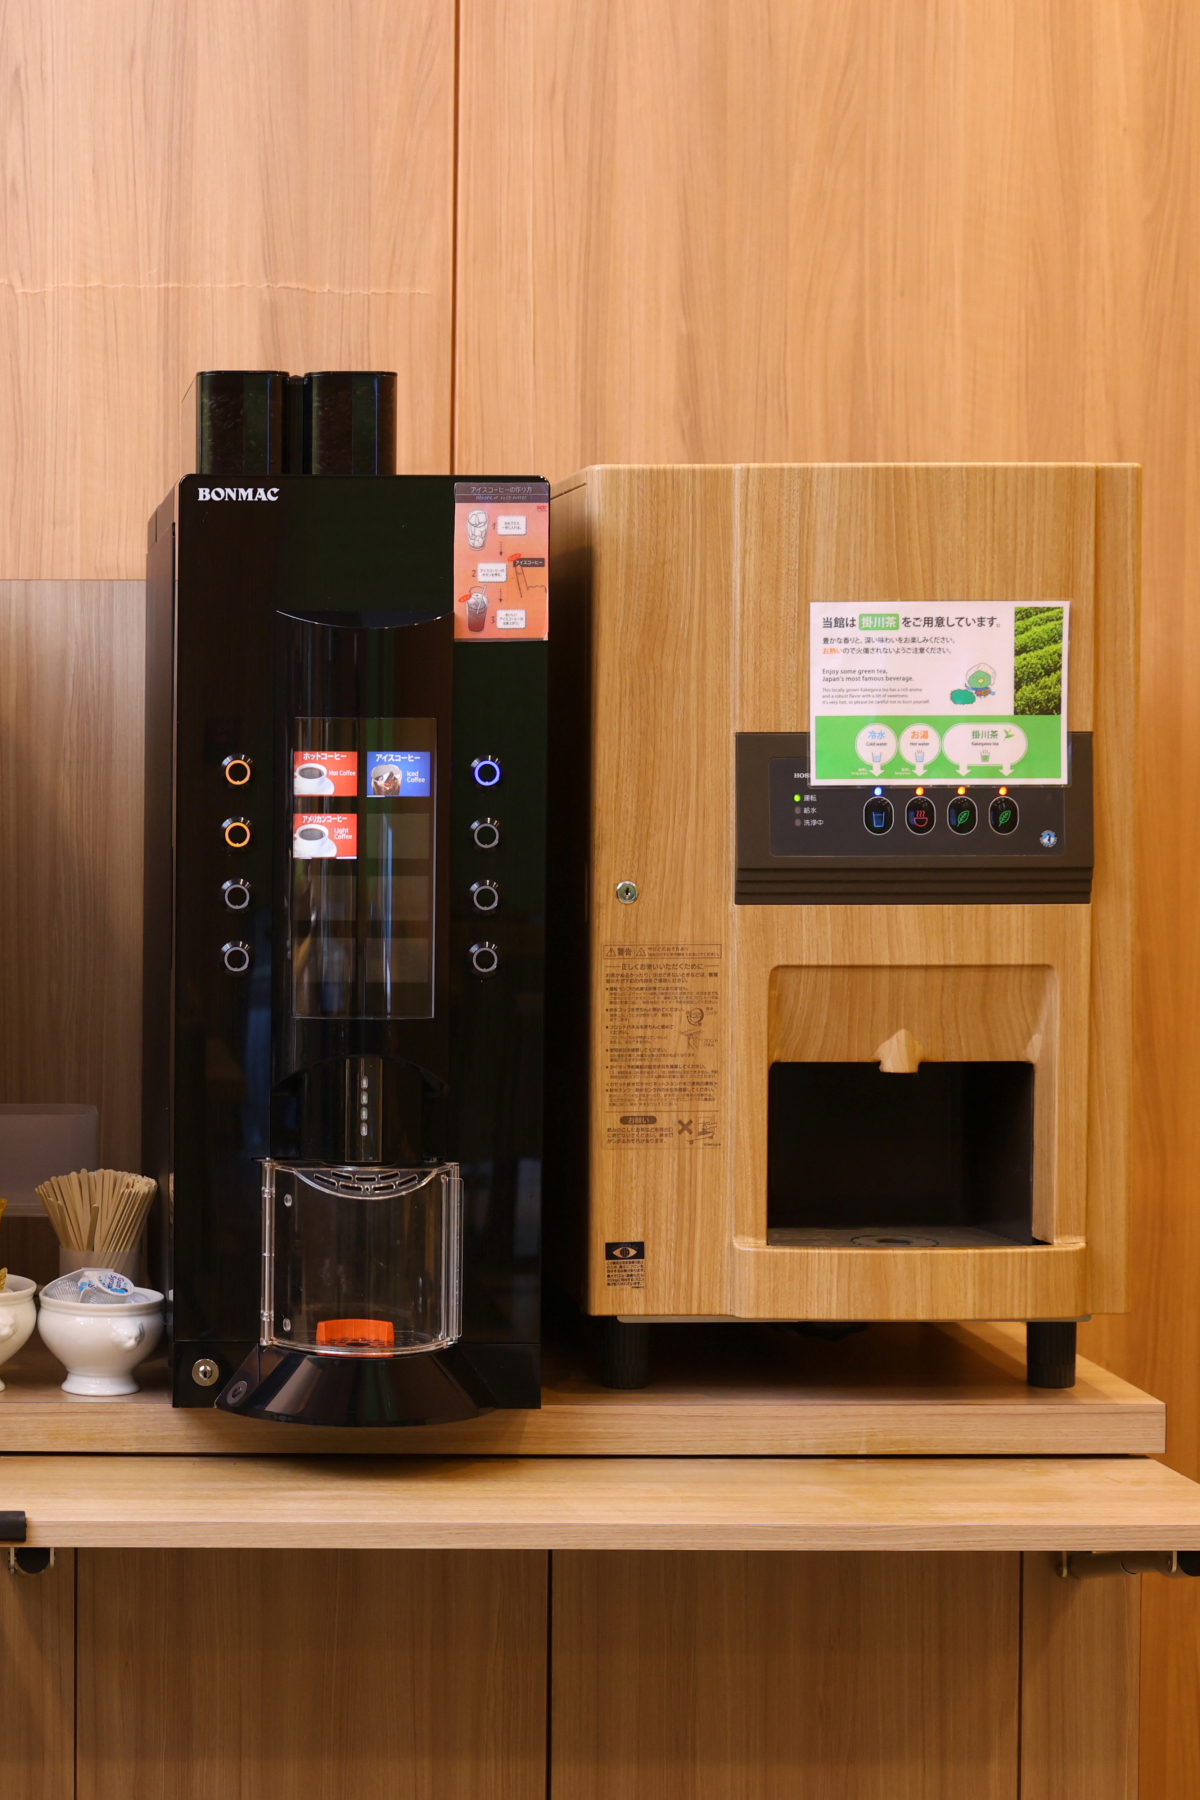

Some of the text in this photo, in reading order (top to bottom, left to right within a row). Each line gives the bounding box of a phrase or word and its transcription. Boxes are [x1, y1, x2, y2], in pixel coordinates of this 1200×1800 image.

[198, 488, 280, 501] BONMAC
[470, 486, 533, 494] アイスコーヒーの作り方
[822, 636, 955, 644] 豊かな香りと、深い味わいをお楽しみください。
[867, 730, 886, 740] 冷水
[910, 730, 929, 740] お湯
[971, 730, 999, 740] 掛川茶
[375, 754, 421, 762] アイスコーヒー
[302, 815, 348, 823] アメリカンコーヒー
